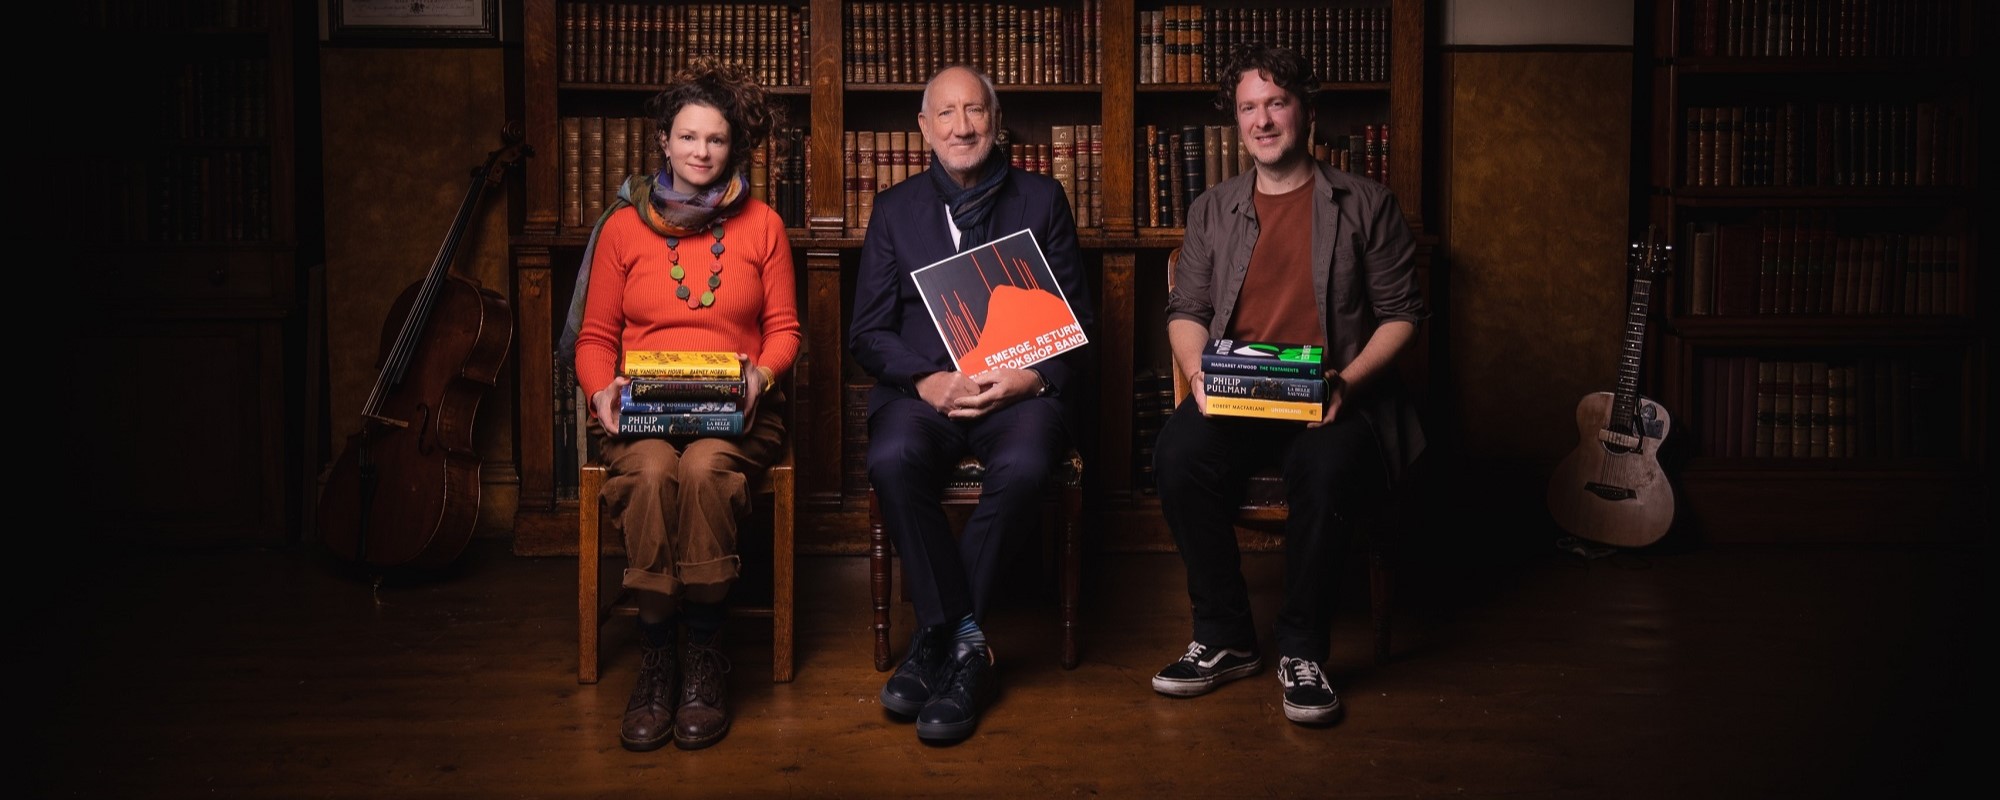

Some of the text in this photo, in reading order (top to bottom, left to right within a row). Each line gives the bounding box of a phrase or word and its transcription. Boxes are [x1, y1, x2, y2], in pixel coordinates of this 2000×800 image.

[985, 323, 1081, 367] EMERGE, RETURN
[1054, 333, 1086, 351] BAND
[1213, 377, 1241, 386] PHILIP
[1206, 384, 1247, 395] PULLMAN
[629, 416, 658, 424] PHILIP
[621, 424, 664, 433] PULLMAN
